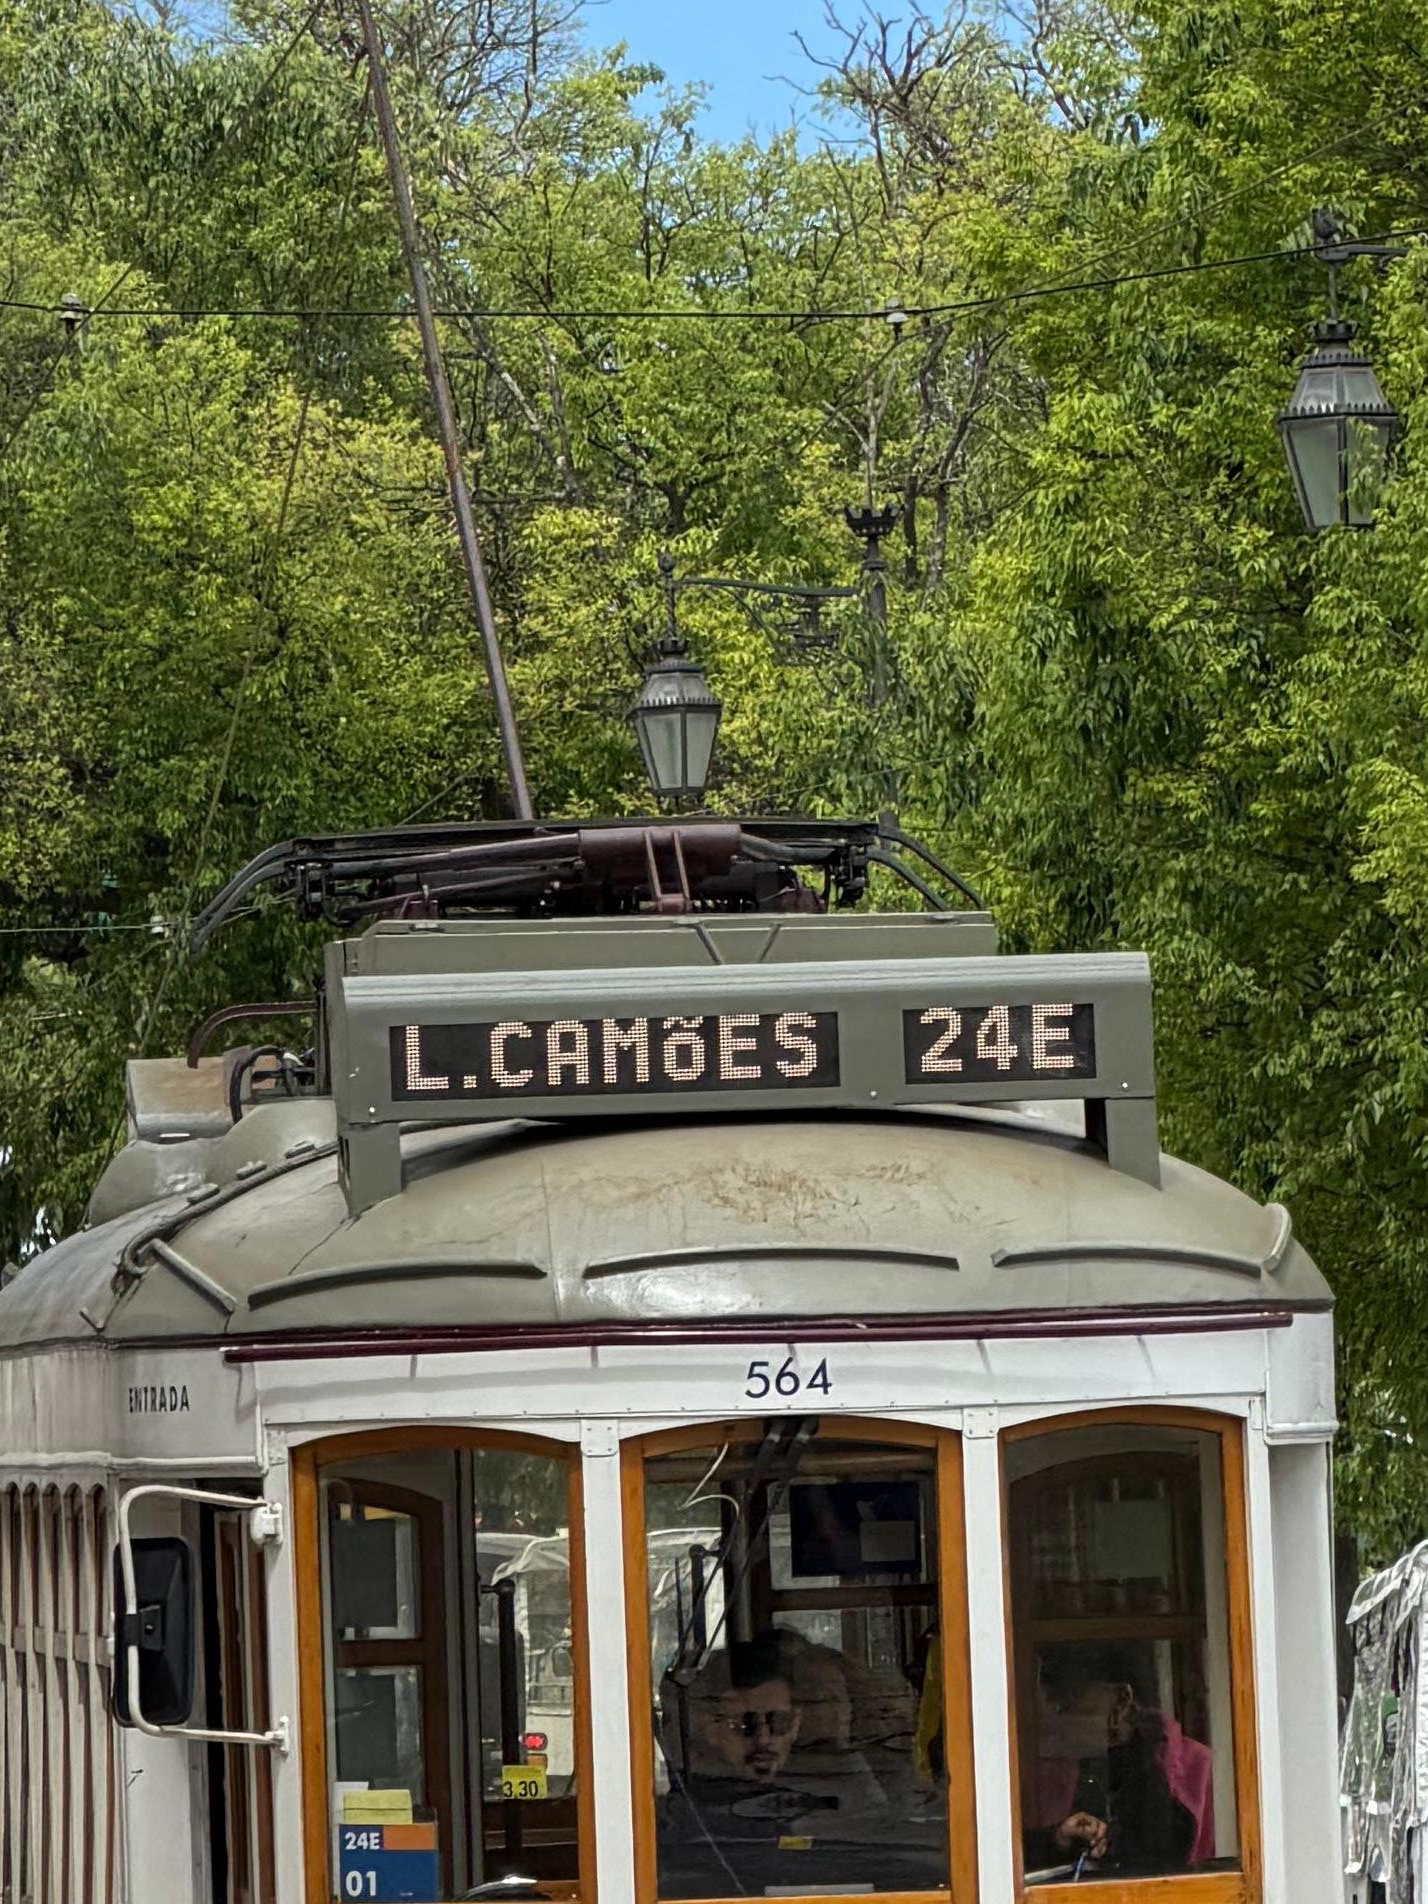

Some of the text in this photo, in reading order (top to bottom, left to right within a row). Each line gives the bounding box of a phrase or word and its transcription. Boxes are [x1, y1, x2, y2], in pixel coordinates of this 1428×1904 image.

[918, 1002, 1075, 1074] 24E
[744, 1356, 834, 1399] 564
[128, 1384, 191, 1415] ENTRADA
[343, 1831, 381, 1851] 24E
[344, 1870, 378, 1898] 01
